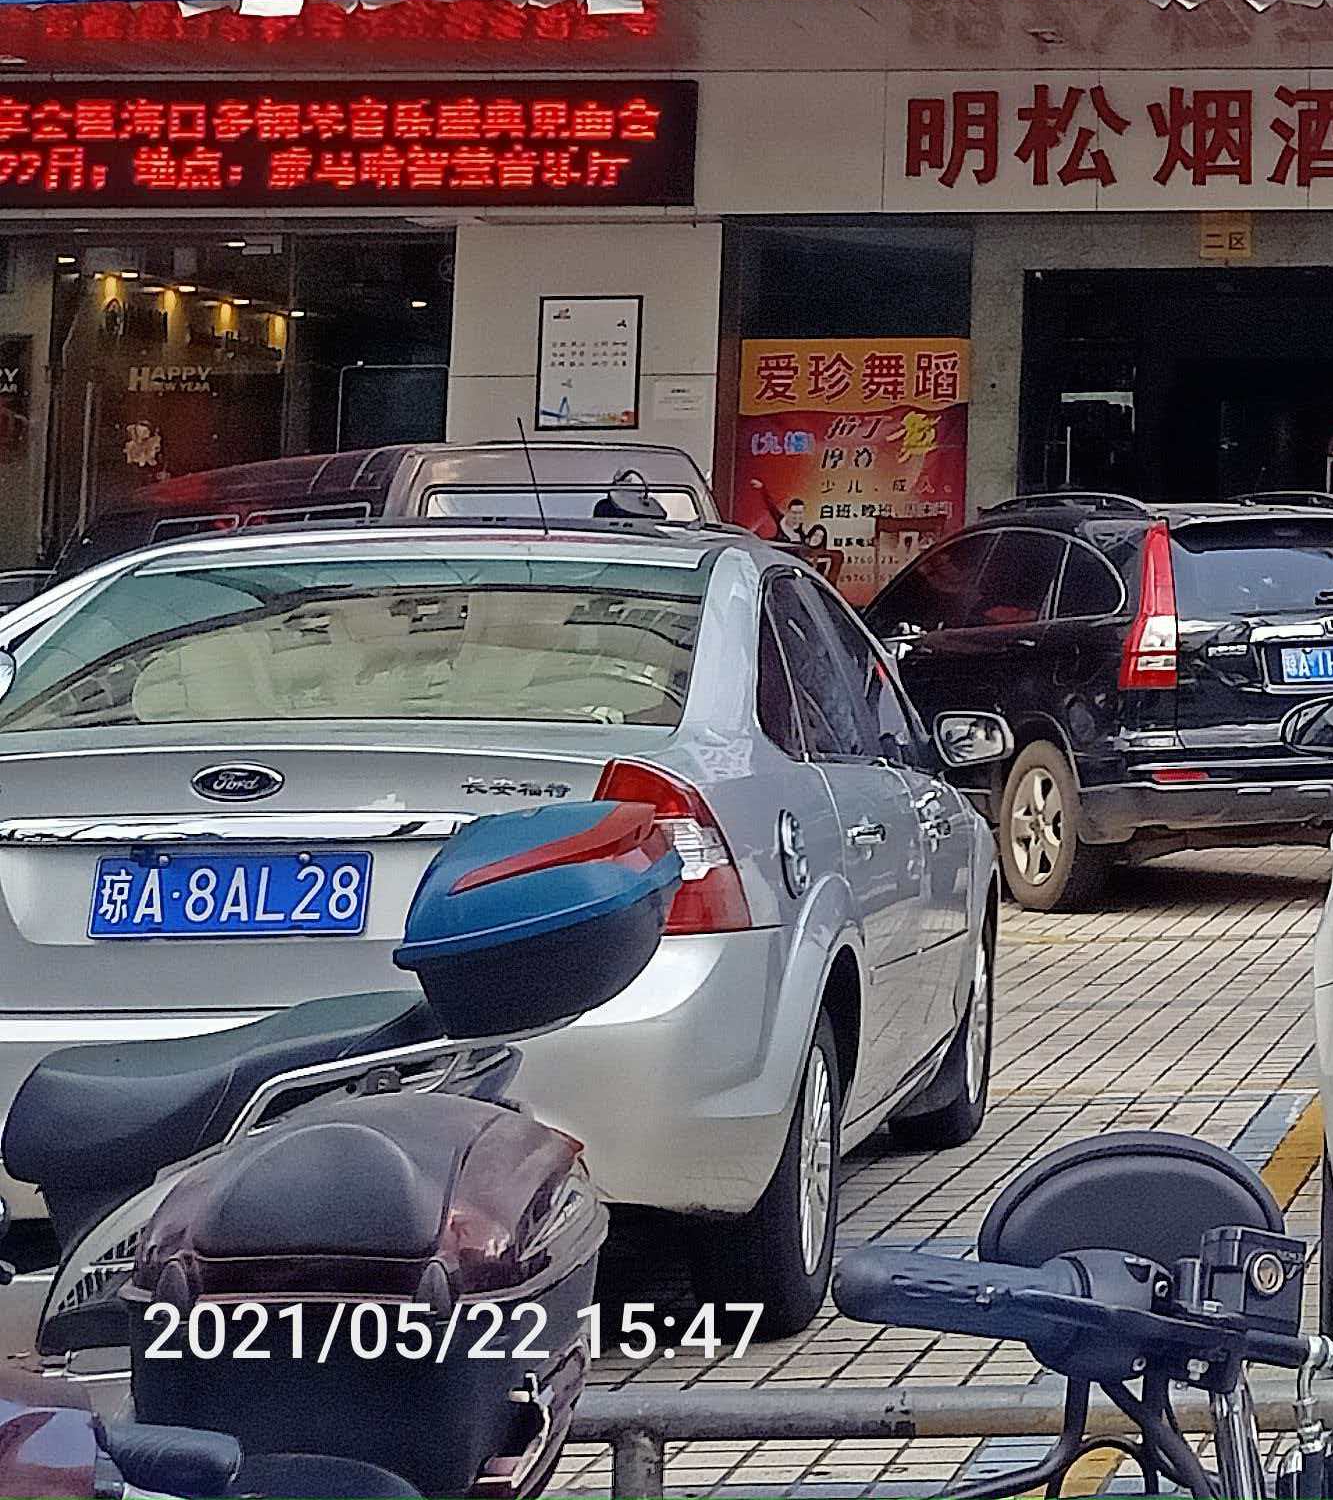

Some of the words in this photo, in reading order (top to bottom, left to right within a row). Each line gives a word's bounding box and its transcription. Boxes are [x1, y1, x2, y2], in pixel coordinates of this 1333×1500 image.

[1203, 231, 1248, 250] 二区
[755, 353, 960, 402] 爱珍舞蹈
